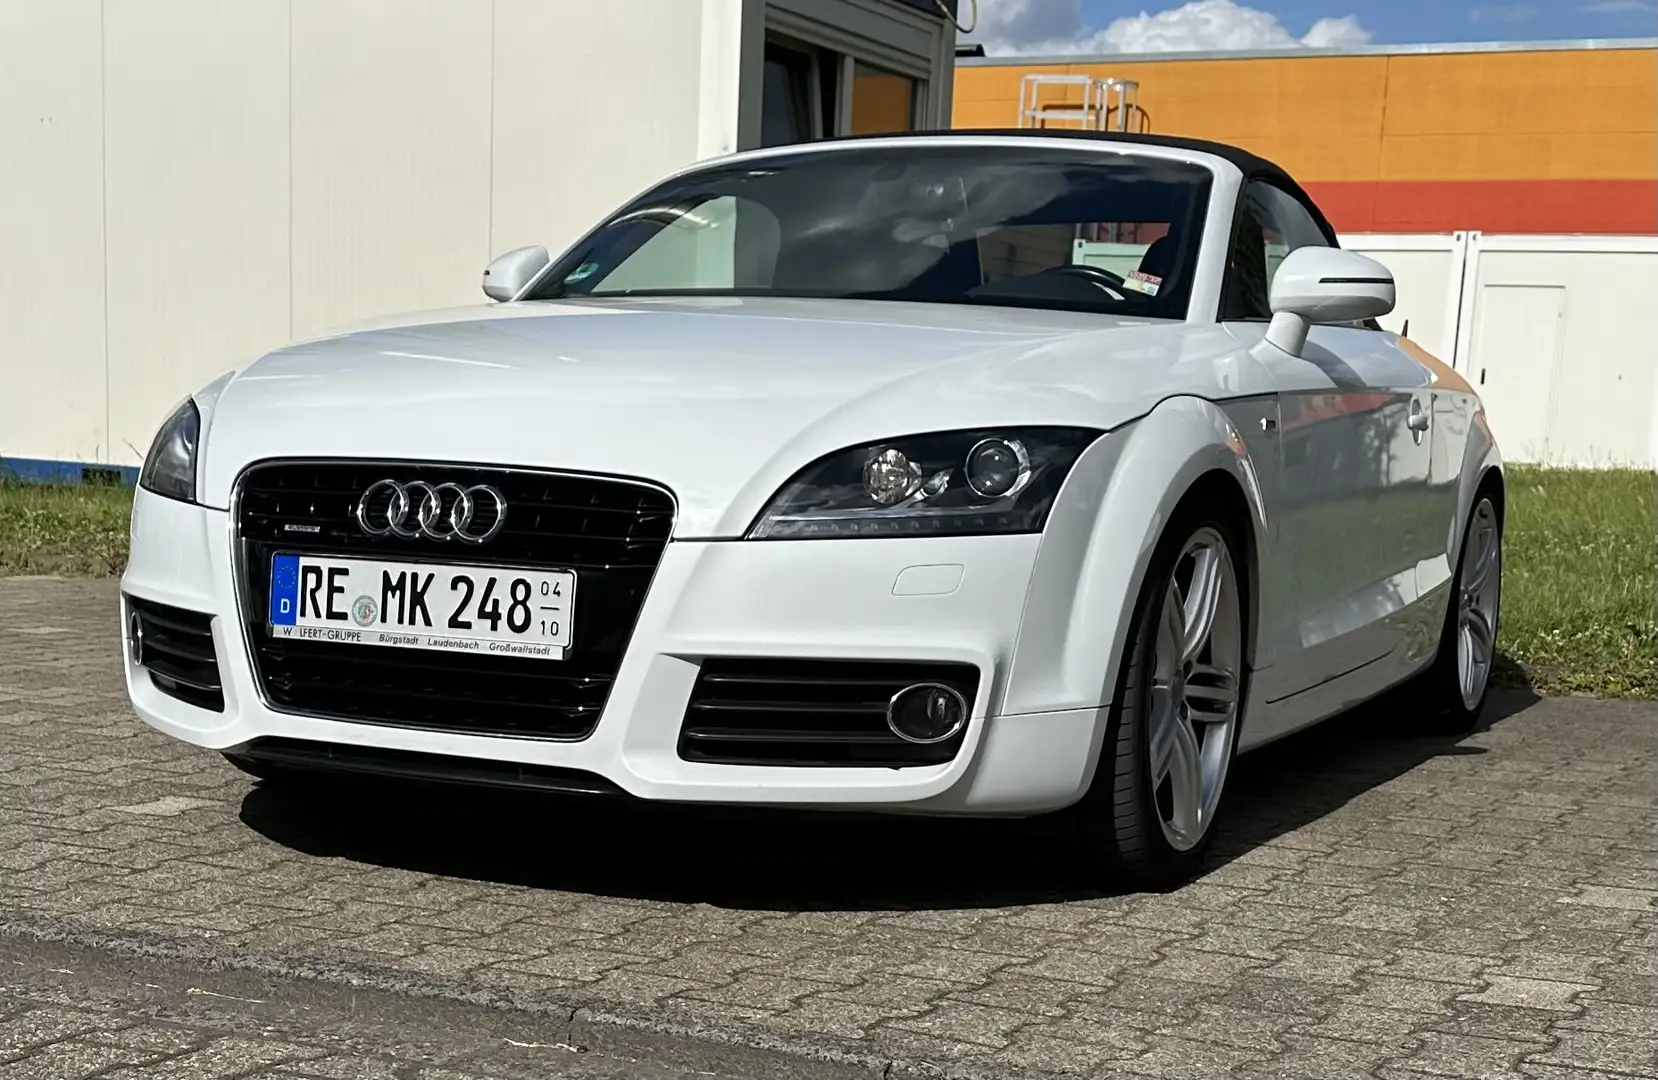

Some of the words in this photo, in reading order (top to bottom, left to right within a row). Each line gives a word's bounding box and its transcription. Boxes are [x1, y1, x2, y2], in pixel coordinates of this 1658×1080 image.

[541, 581, 561, 597] 04
[280, 599, 290, 612] D
[299, 565, 349, 620] RE
[380, 570, 435, 626] MK
[447, 575, 532, 633] 248
[541, 620, 559, 636] 10
[427, 638, 479, 650] Laudenbach
[489, 642, 551, 655] Großwallstadt
